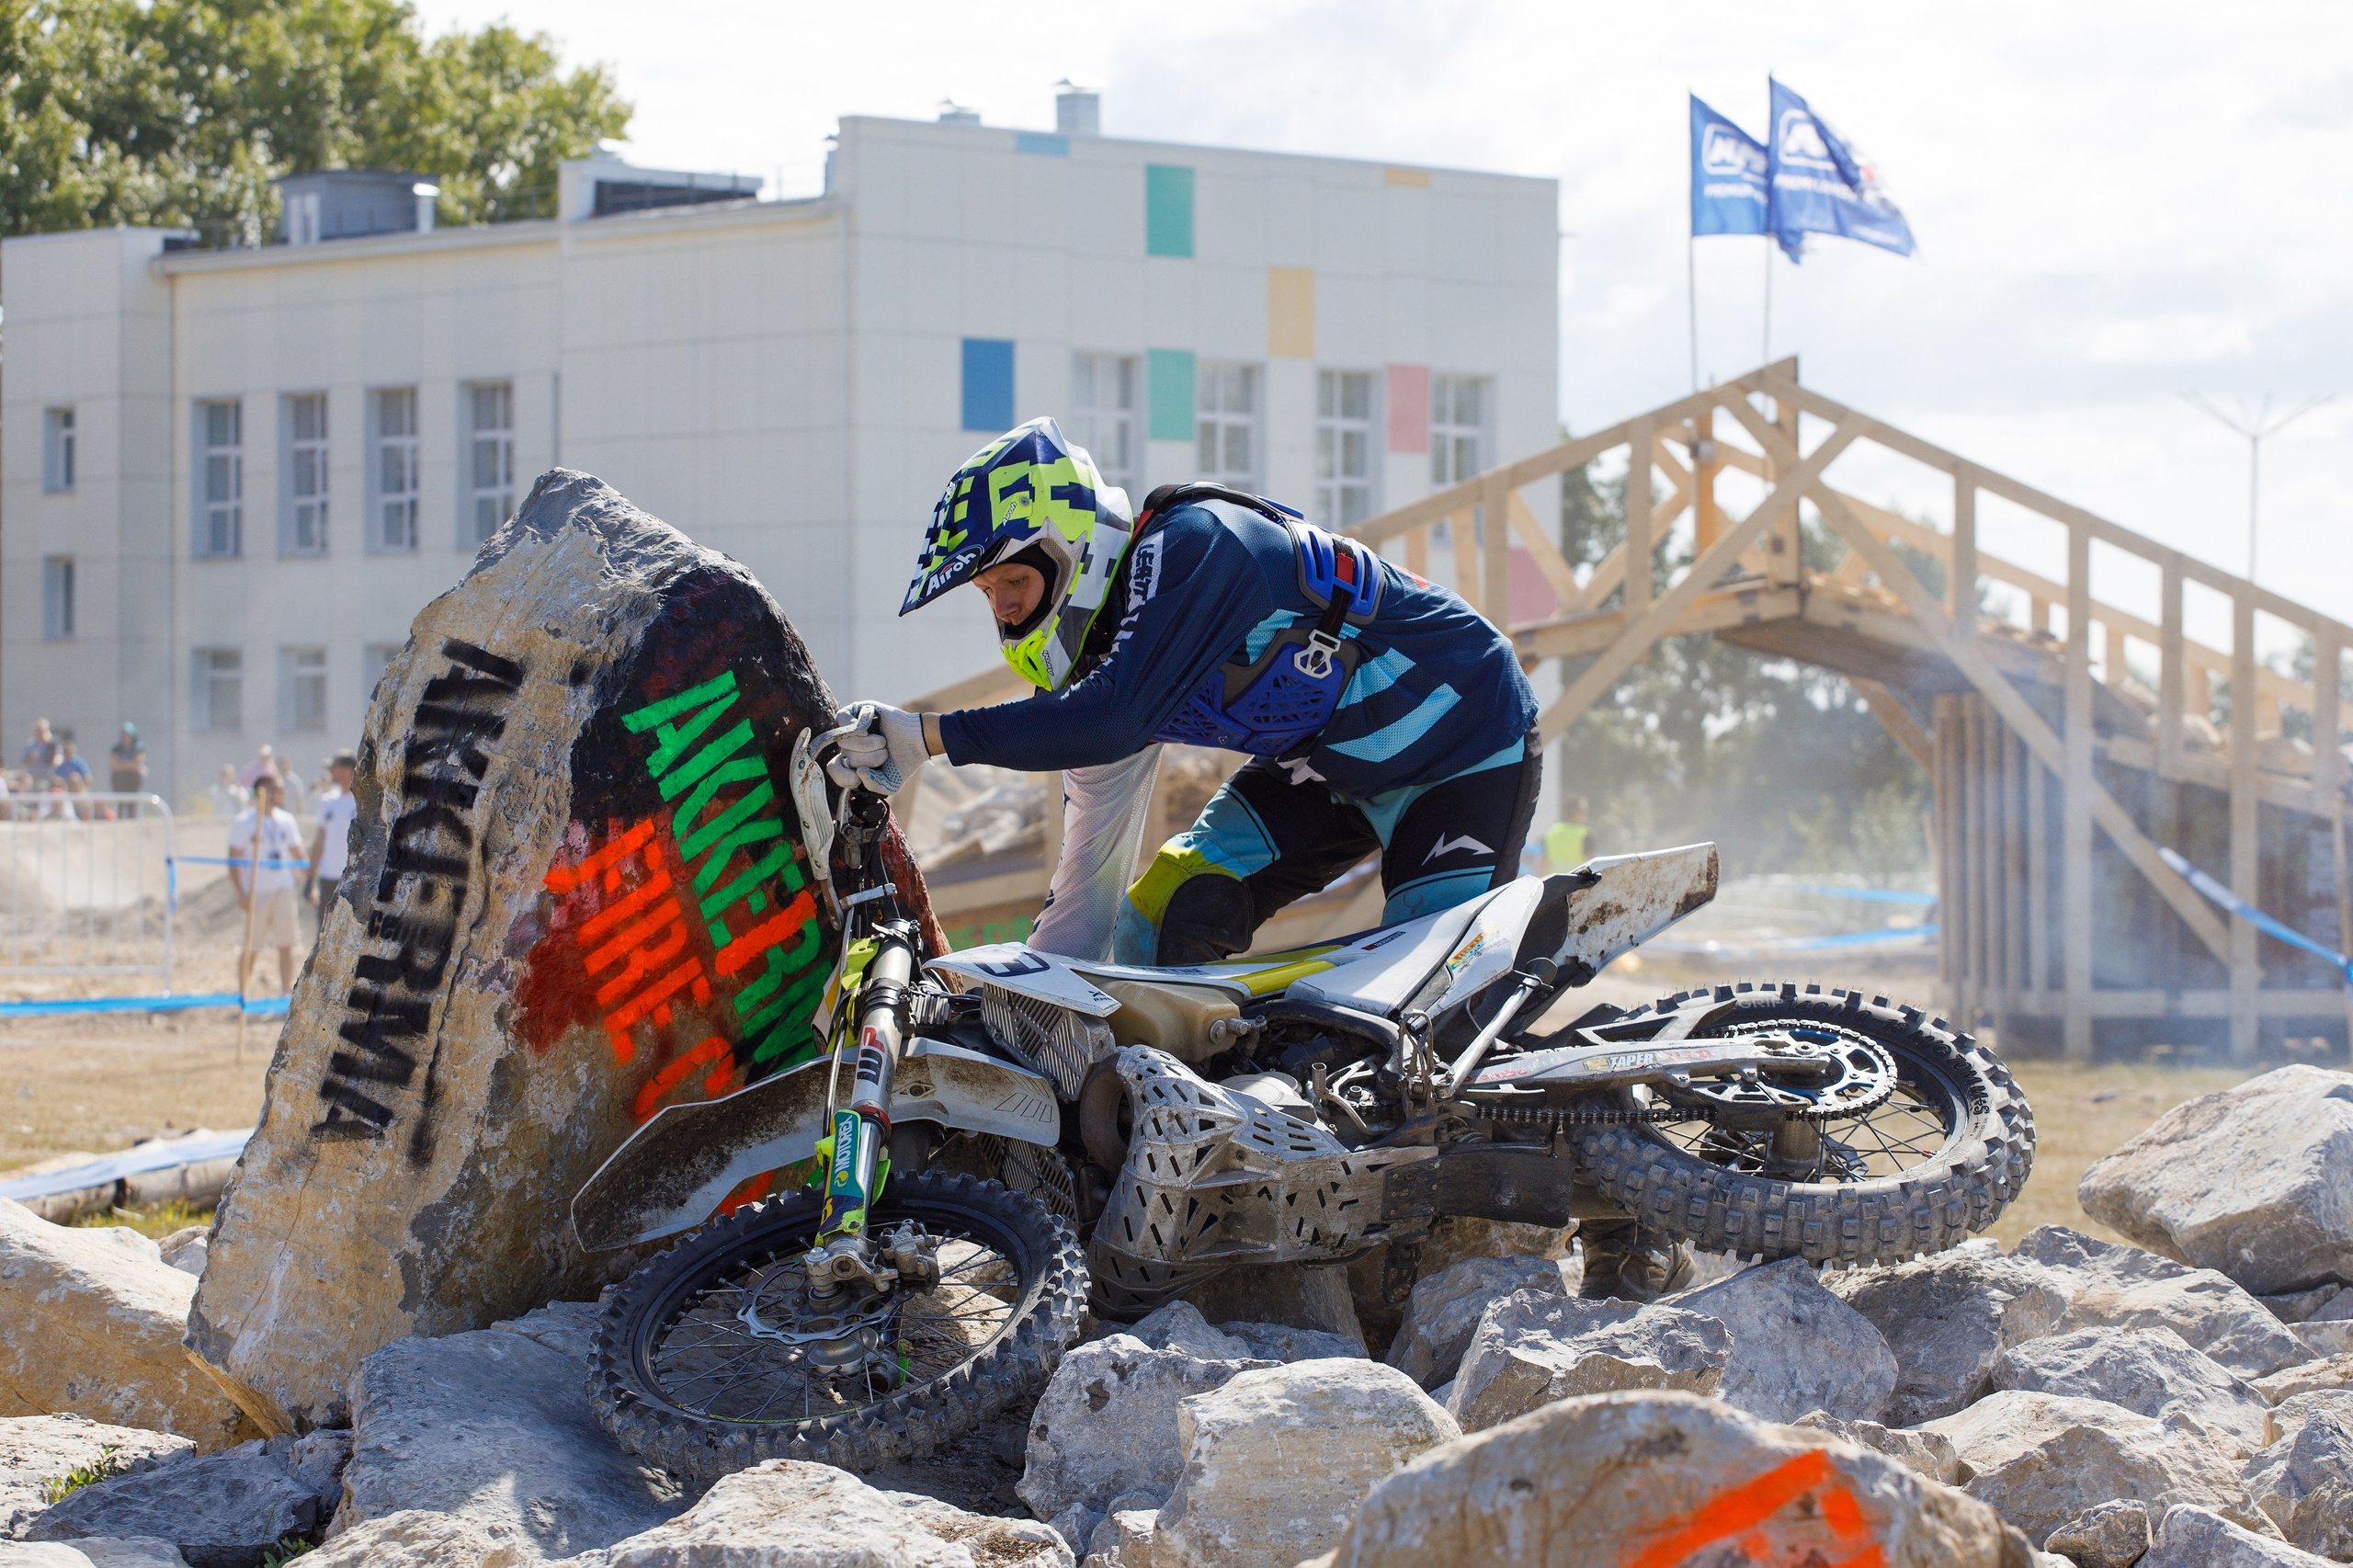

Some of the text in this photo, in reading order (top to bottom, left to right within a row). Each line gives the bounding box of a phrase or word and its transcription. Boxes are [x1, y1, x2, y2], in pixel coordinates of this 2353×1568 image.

[1002, 501, 1017, 527] Airoh
[926, 551, 978, 597] Airoh
[1132, 543, 1155, 600] LEATT
[857, 1027, 885, 1086] WP
[1608, 1052, 1654, 1068] TAPER
[835, 1114, 853, 1174] MOTOREX
